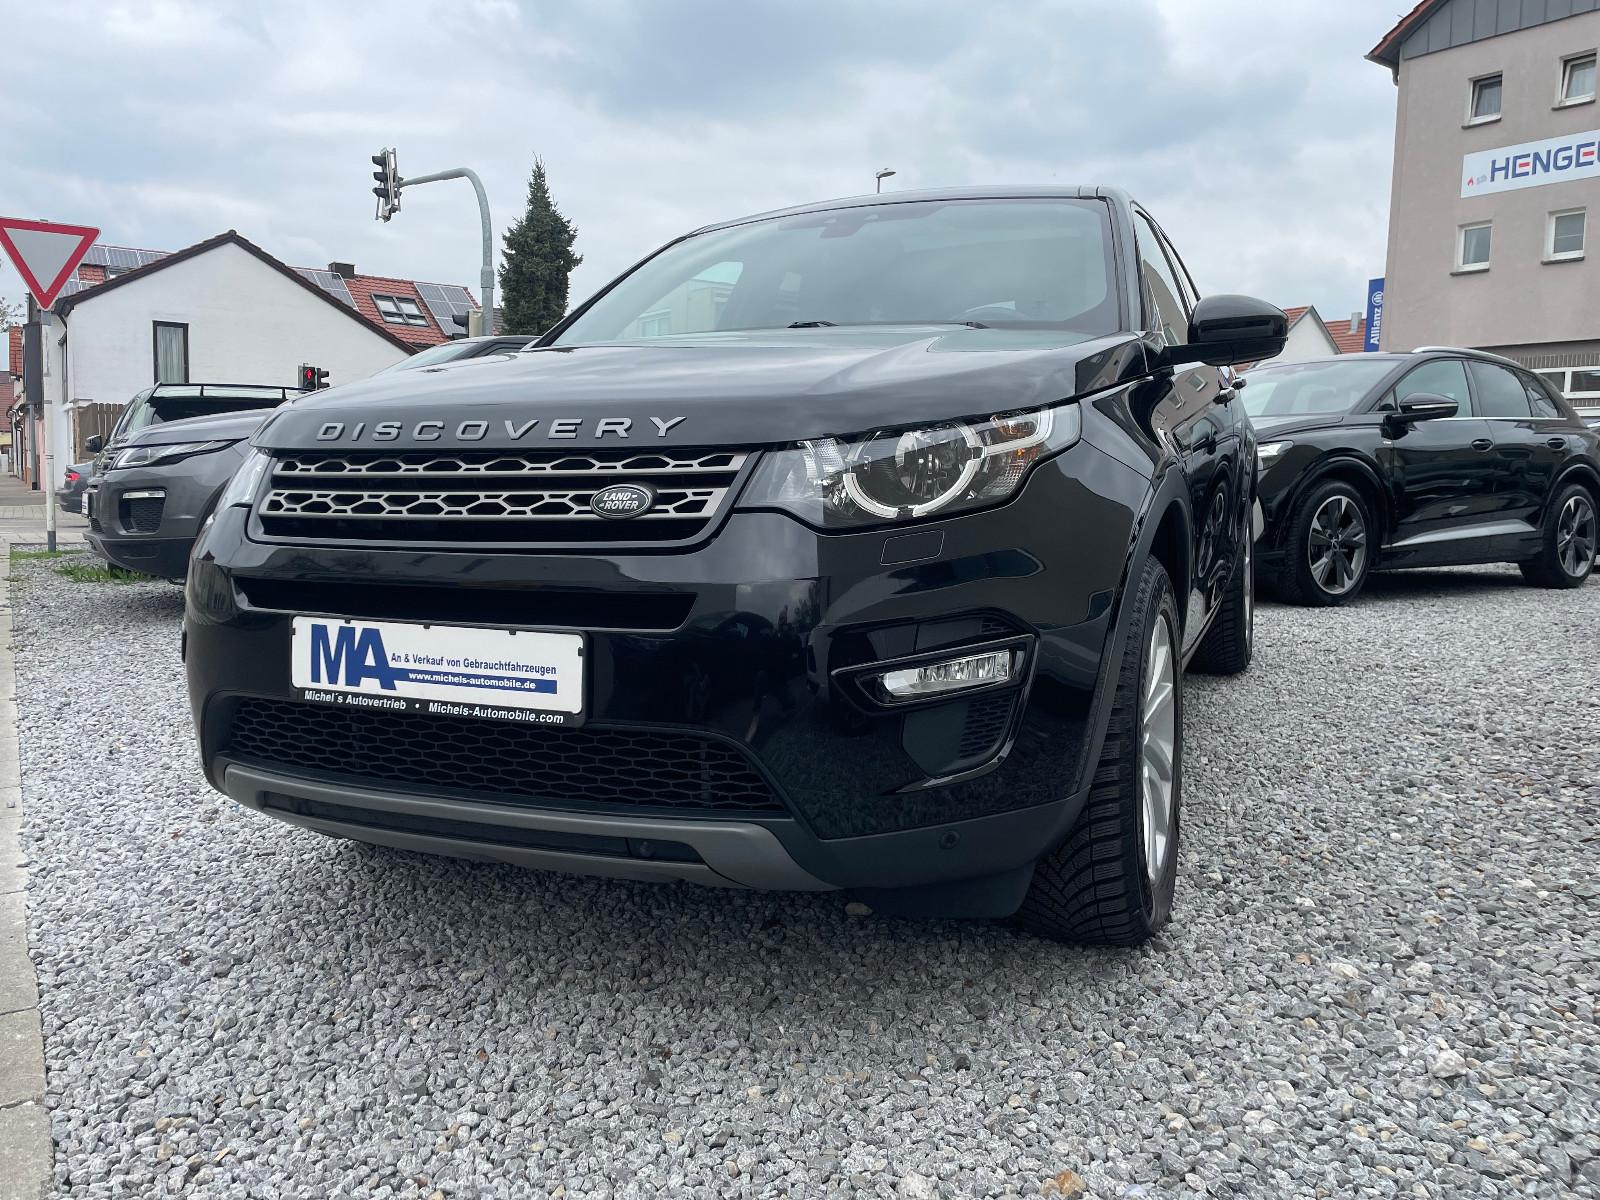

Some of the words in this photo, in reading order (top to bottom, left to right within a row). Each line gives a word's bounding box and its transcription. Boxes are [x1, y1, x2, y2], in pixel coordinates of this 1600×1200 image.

[1490, 141, 1600, 182] HENGE
[1370, 307, 1382, 345] Allianz
[315, 416, 686, 441] DISCOVERY
[311, 624, 396, 690] MA
[391, 653, 401, 662] An
[404, 654, 410, 663] &
[412, 654, 444, 666] Verkauf
[446, 658, 461, 667] von
[463, 658, 556, 676] Gebrauchtfahrzeugen
[408, 672, 537, 689] www.michels-automobile.de
[345, 694, 406, 709] Autovertrieb
[428, 702, 564, 724] Michels-Automobile.com
